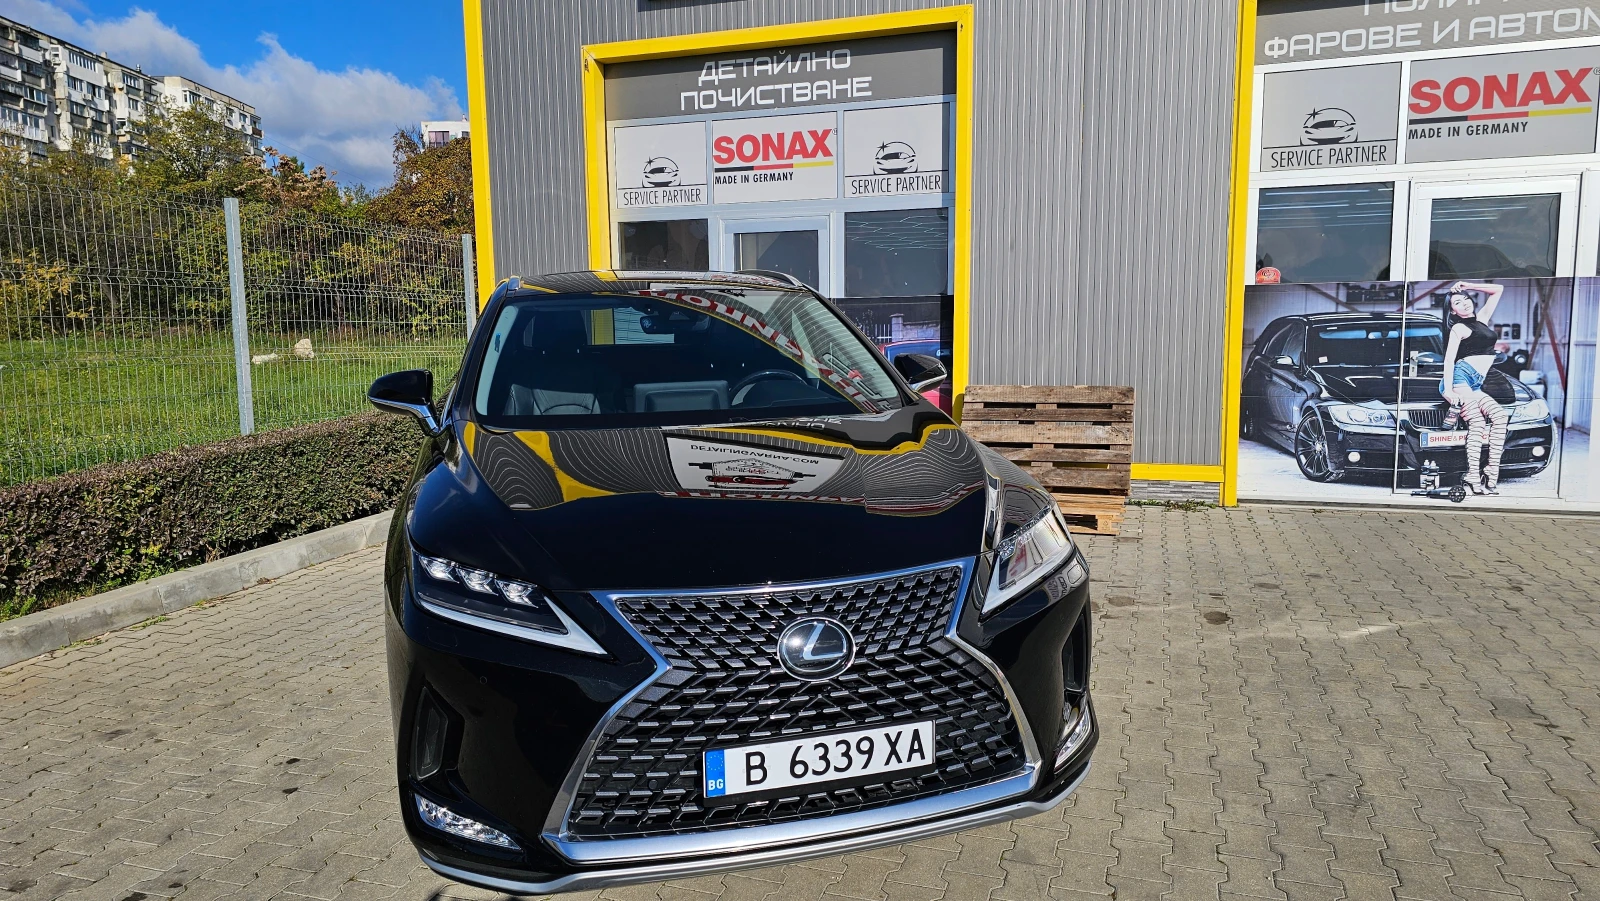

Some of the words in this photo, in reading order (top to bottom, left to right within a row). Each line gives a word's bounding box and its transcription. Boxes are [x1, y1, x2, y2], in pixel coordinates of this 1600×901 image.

[1264, 22, 1423, 59] ФАРОВЕ
[1433, 18, 1460, 44] И
[698, 48, 851, 86] ДЕТАЙЛНО
[680, 76, 873, 111] ПОЧИСТВАНЕ
[1408, 67, 1594, 115] SONAX
[1408, 127, 1442, 140] MADE
[1447, 126, 1460, 137] IN
[1466, 121, 1529, 136] GERMANY
[713, 128, 834, 165] SONAX
[1271, 148, 1323, 169] SERVICE
[1328, 145, 1387, 165] PARTNER
[714, 174, 738, 185] MADE
[740, 173, 750, 184] IN
[753, 171, 794, 183] GERMANY
[851, 177, 892, 195] SERVICE
[896, 175, 941, 193] PARTNER
[623, 190, 659, 206] SERVICE
[662, 188, 701, 204] PARTNER
[789, 735, 875, 779] 6339
[708, 778, 724, 791] BG
